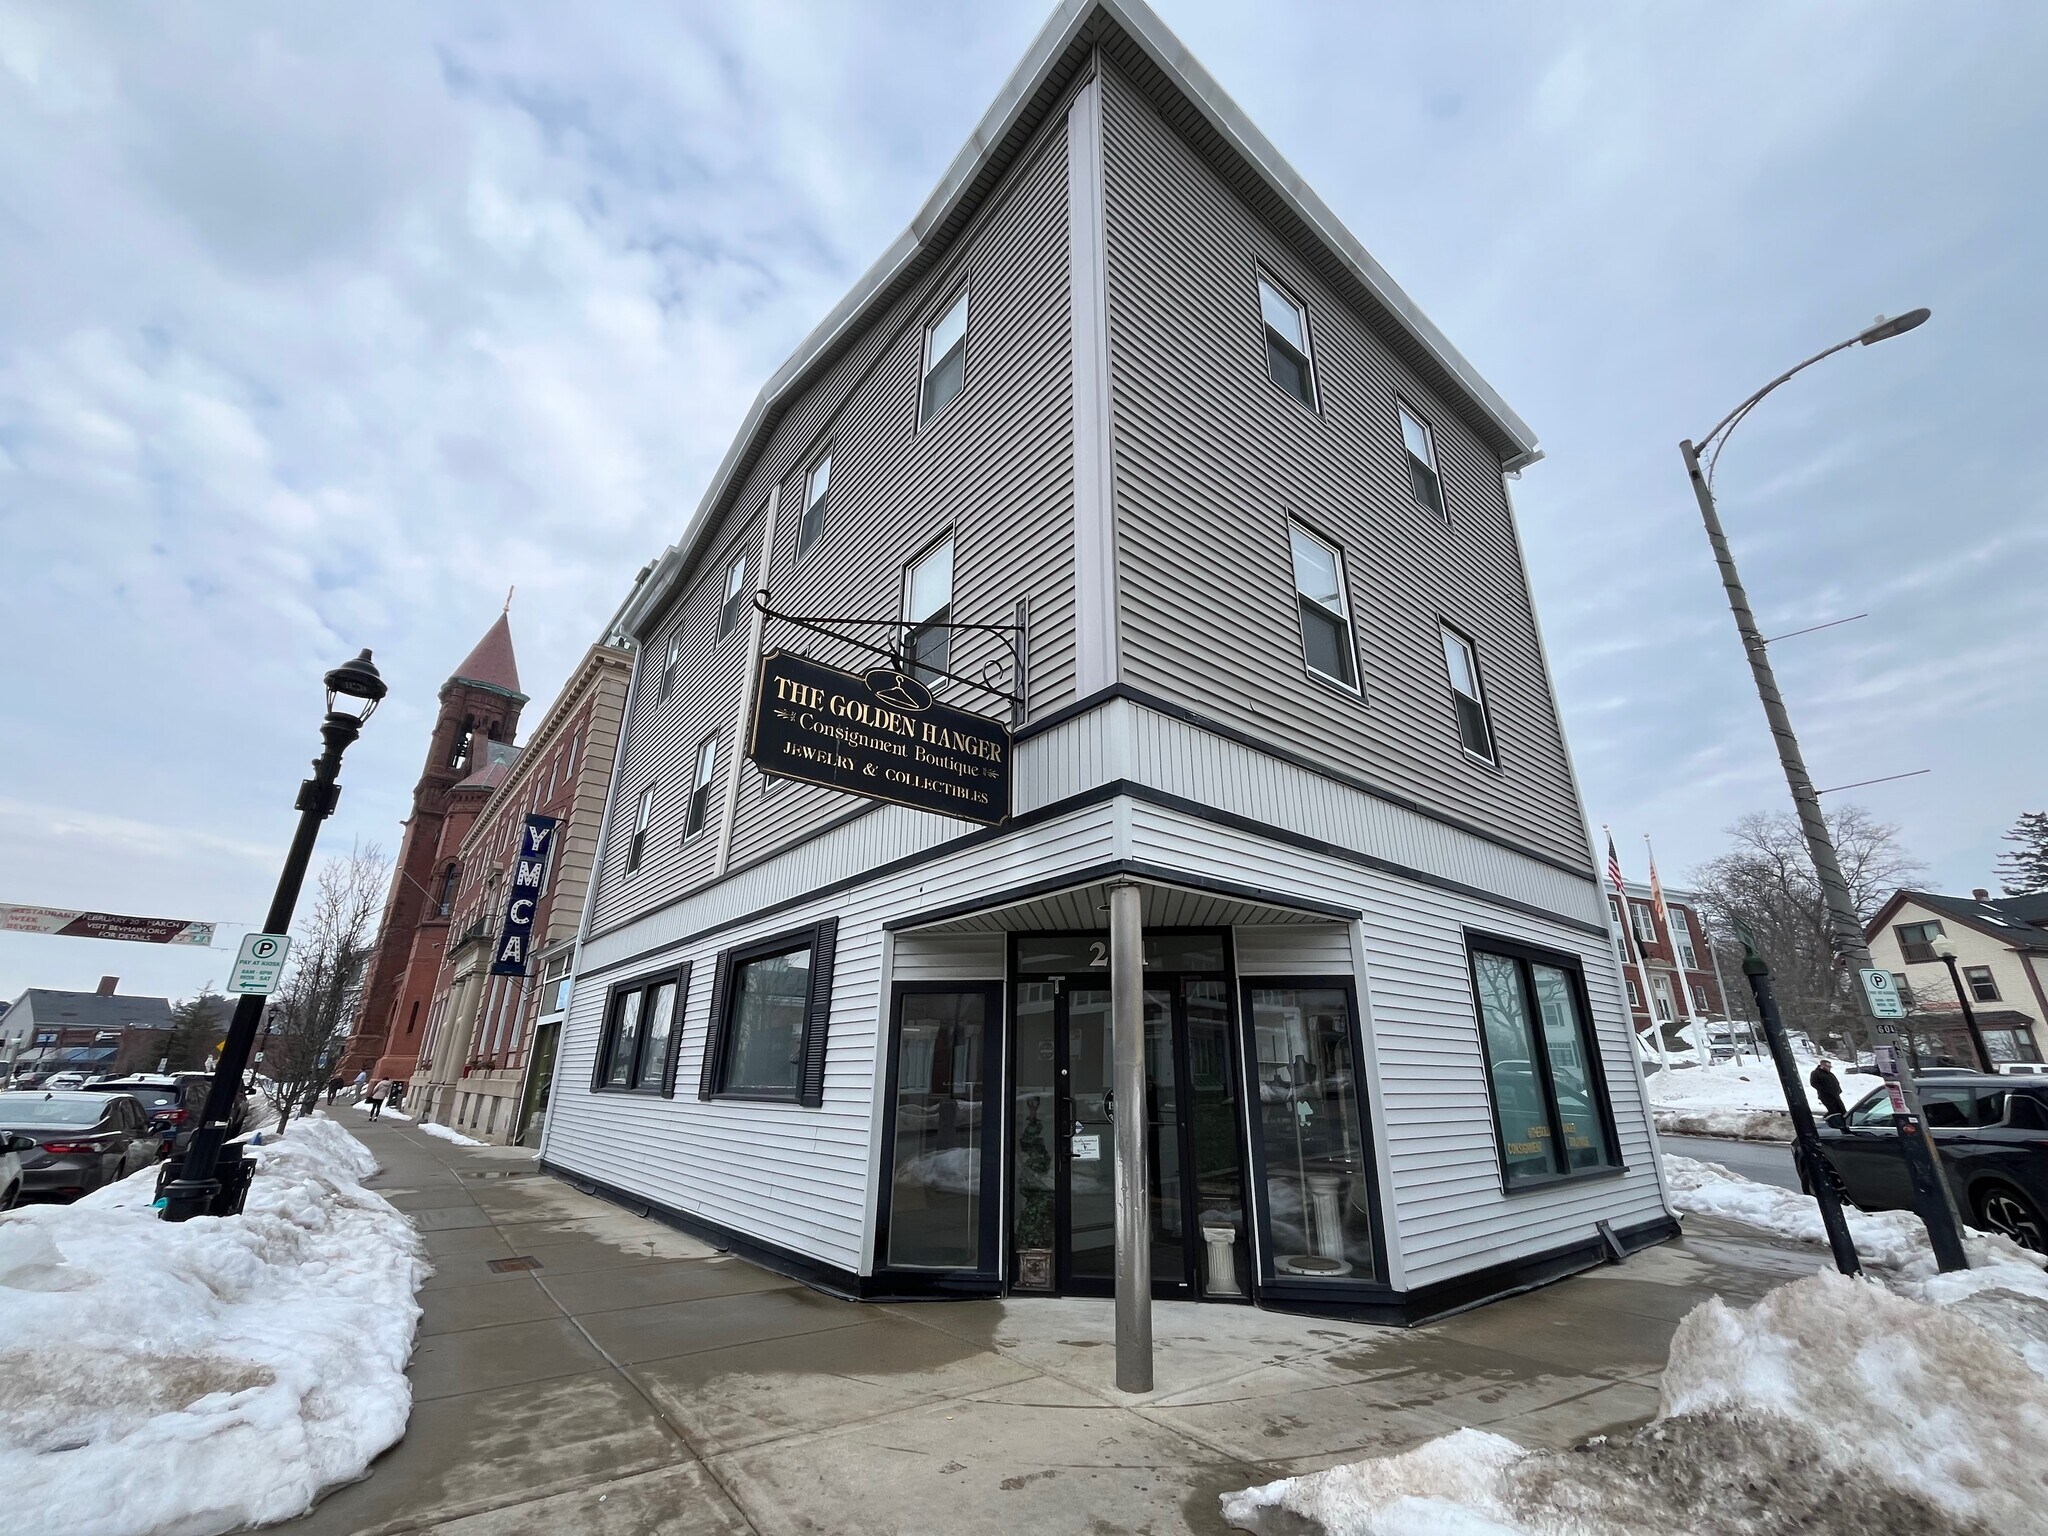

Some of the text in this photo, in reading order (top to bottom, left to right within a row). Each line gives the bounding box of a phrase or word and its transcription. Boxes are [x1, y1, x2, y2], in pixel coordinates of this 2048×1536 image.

[774, 675, 1002, 763] THE GOLDEN HANGER
[799, 712, 979, 779] Consignment Boutique
[783, 741, 989, 804] JEWELRY & COLLECTIBLES
[500, 826, 550, 963] YMCA
[82, 913, 128, 925] FEBRUARY
[147, 919, 180, 929] MARCH
[87, 922, 167, 935] VISIT BEVMAIN.ORG
[98, 931, 151, 941] FOR DETAILS
[258, 942, 273, 955] P
[1873, 976, 1883, 986] P
